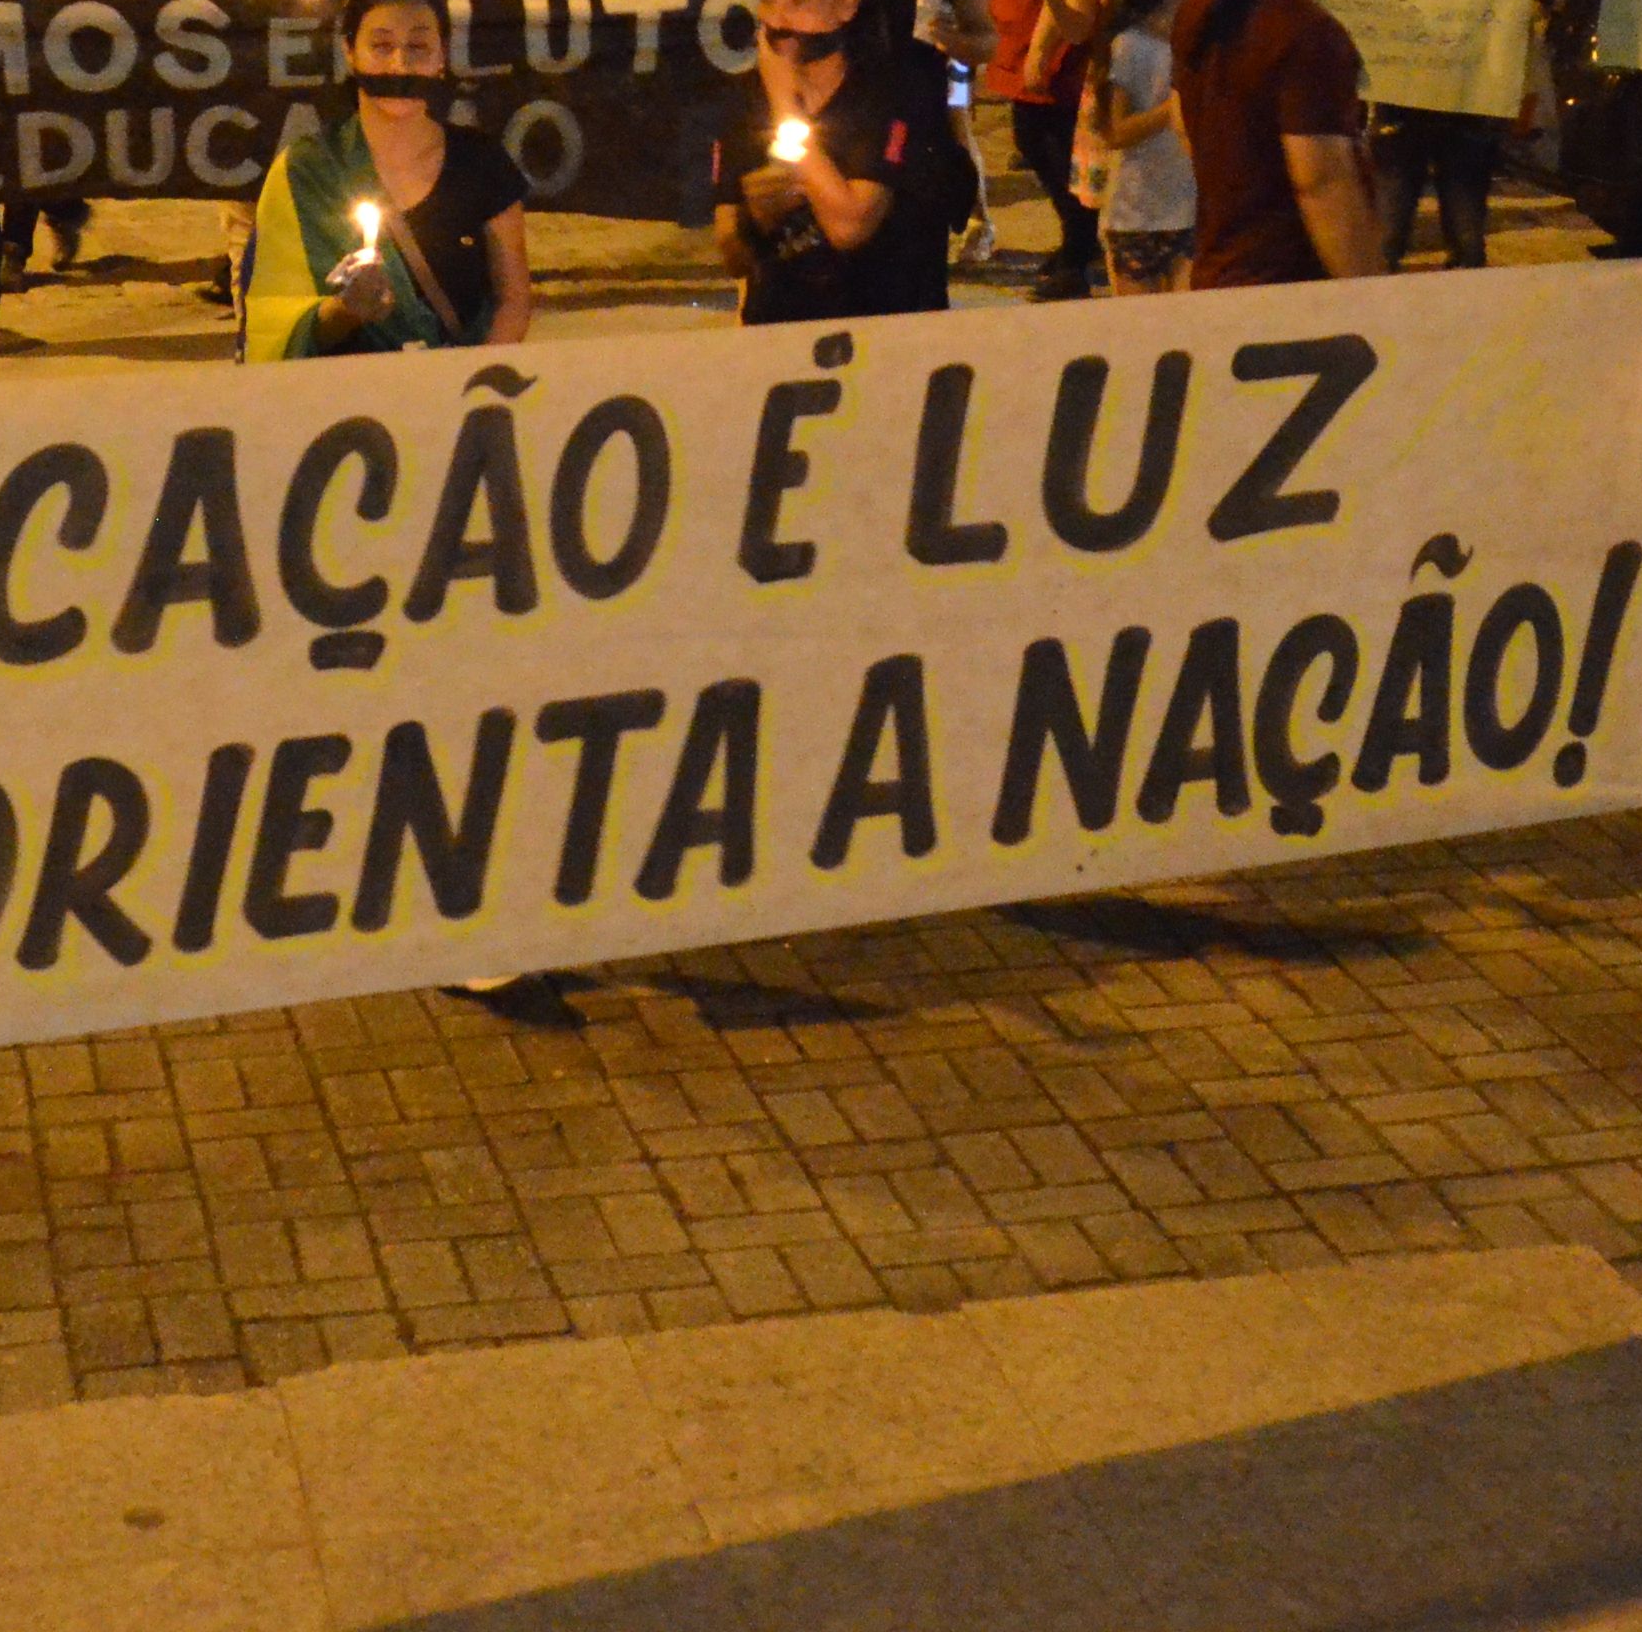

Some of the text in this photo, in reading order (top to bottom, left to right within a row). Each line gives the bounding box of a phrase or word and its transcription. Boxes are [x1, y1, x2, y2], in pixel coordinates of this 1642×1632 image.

[268, 14, 351, 90] E
[737, 331, 854, 584] É
[904, 332, 1380, 568] LUZ
[810, 652, 937, 872] A
